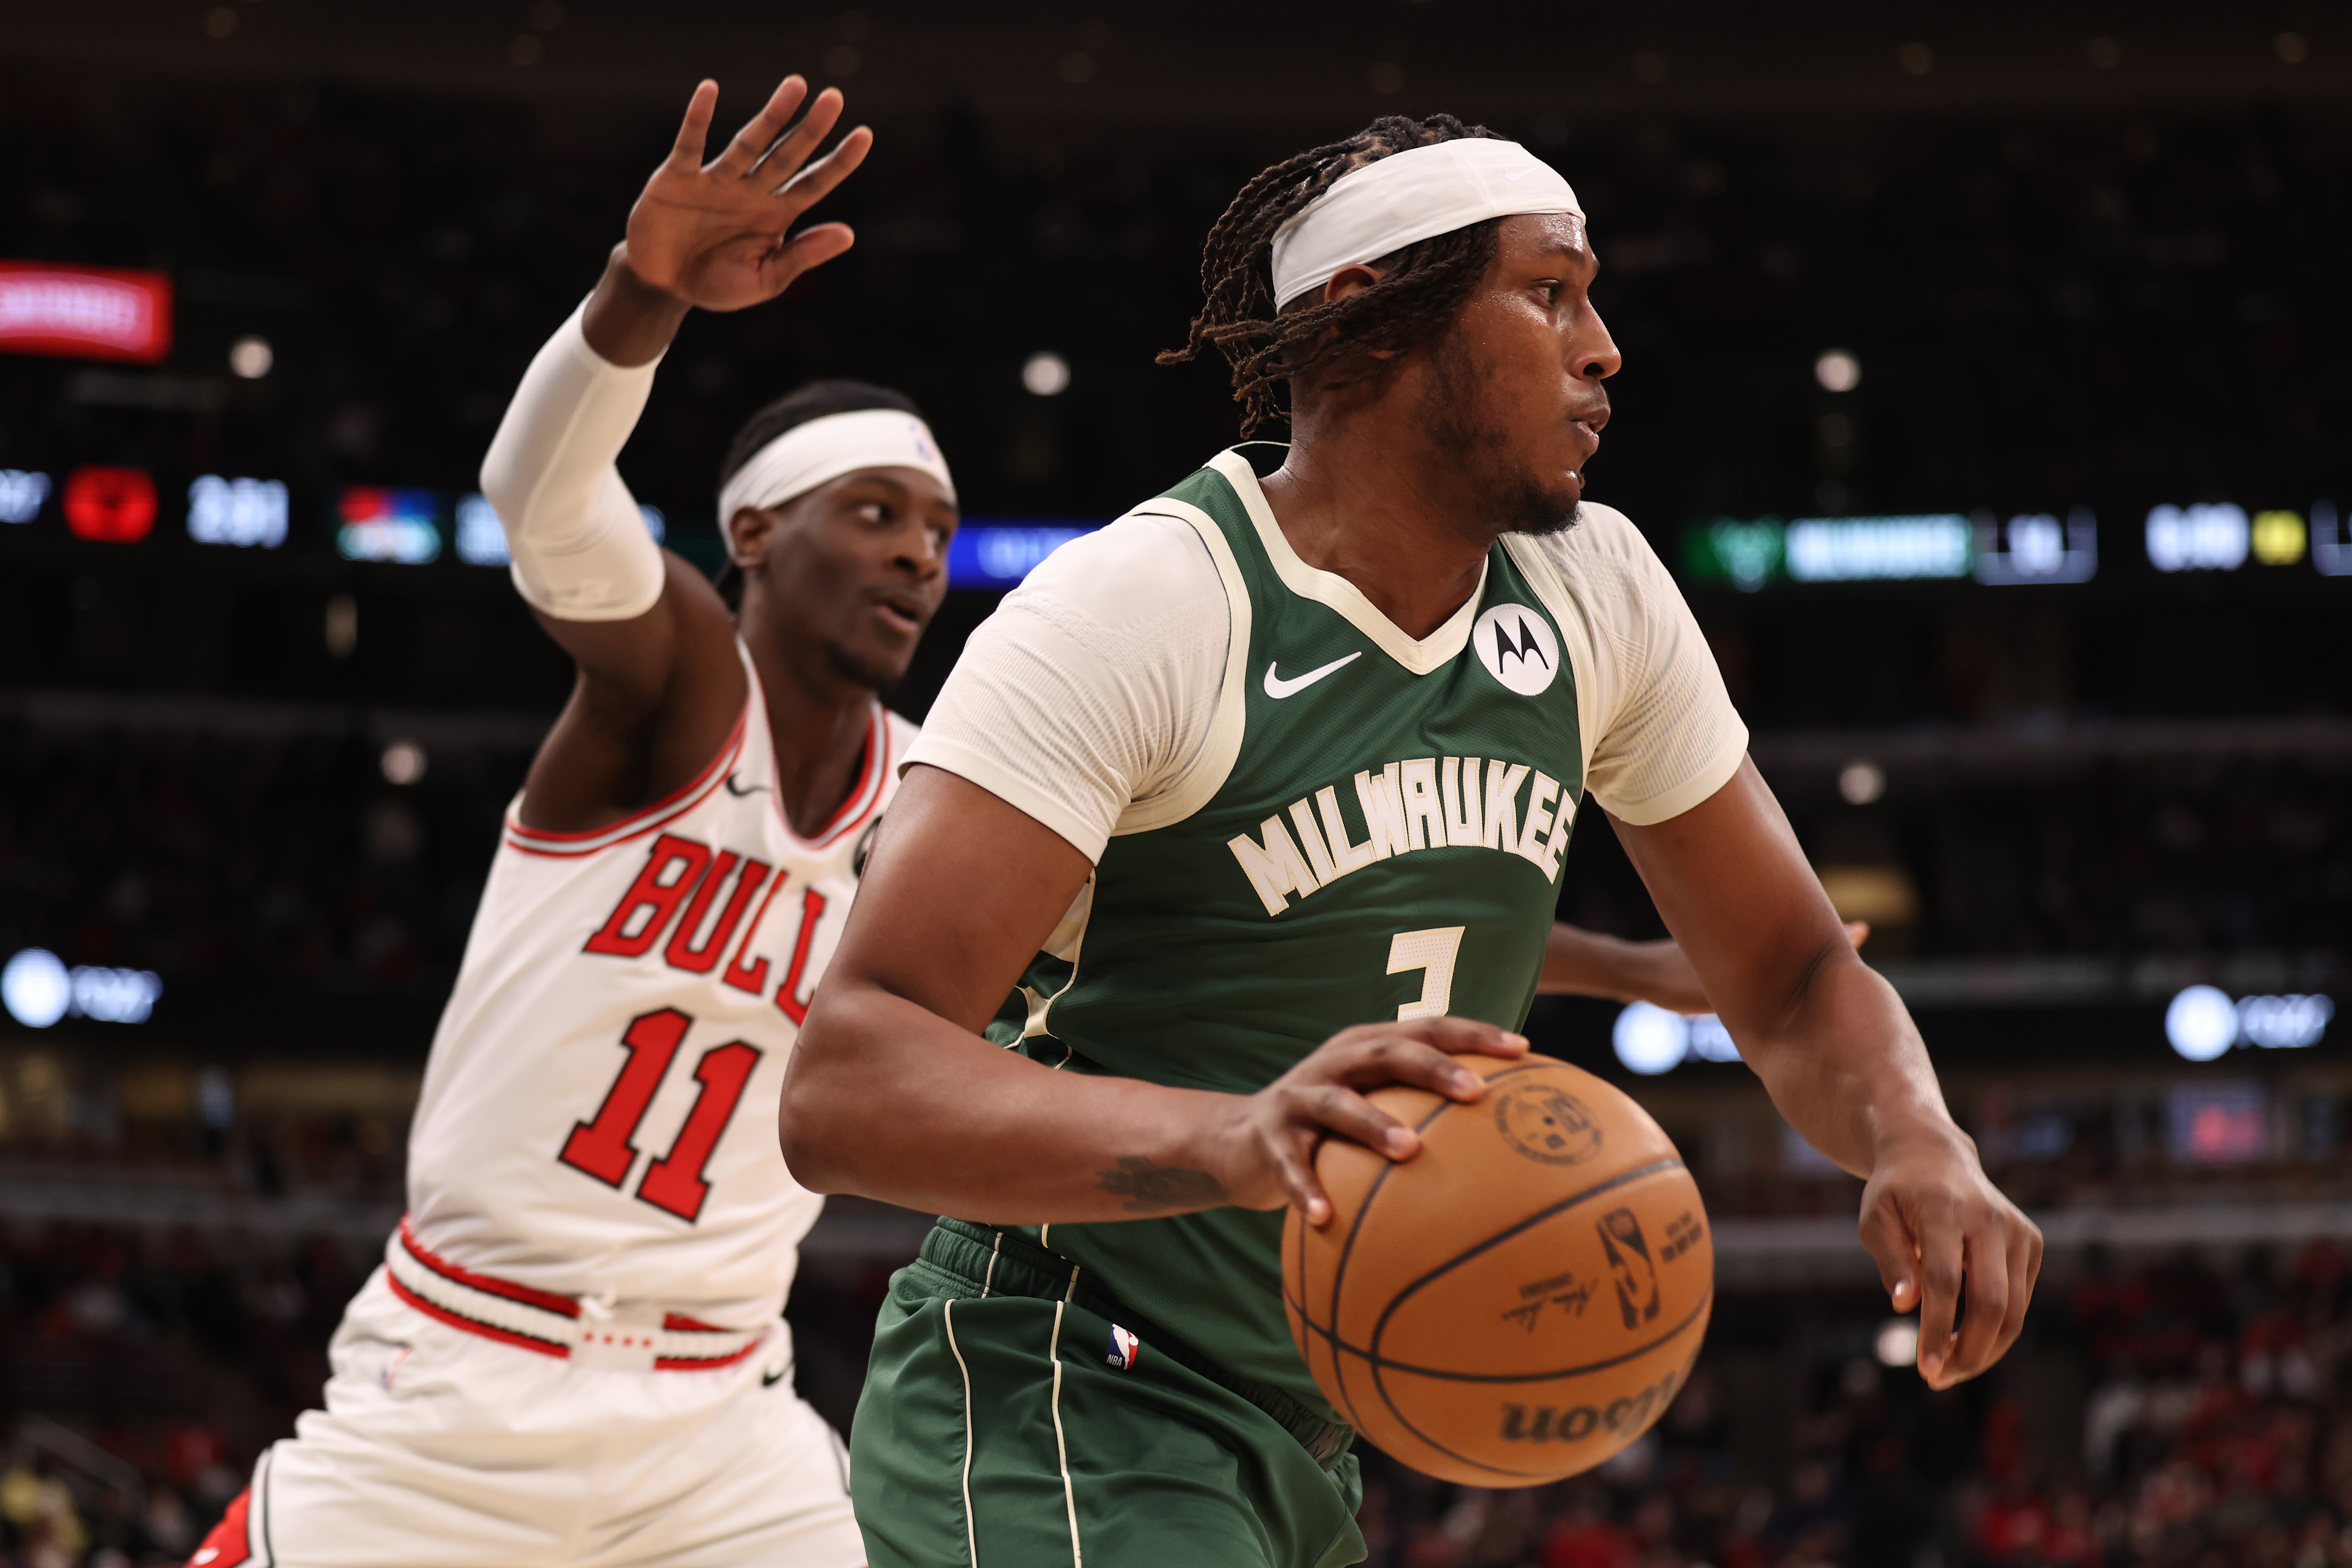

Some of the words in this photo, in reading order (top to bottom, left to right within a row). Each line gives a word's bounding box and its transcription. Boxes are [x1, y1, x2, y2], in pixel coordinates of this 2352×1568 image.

[1226, 756, 1577, 917] MILWAUKEE
[581, 832, 828, 1028] BULL
[557, 1005, 766, 1226] 11
[1106, 1354, 1122, 1366] NBA
[1499, 1367, 1680, 1445] lson
